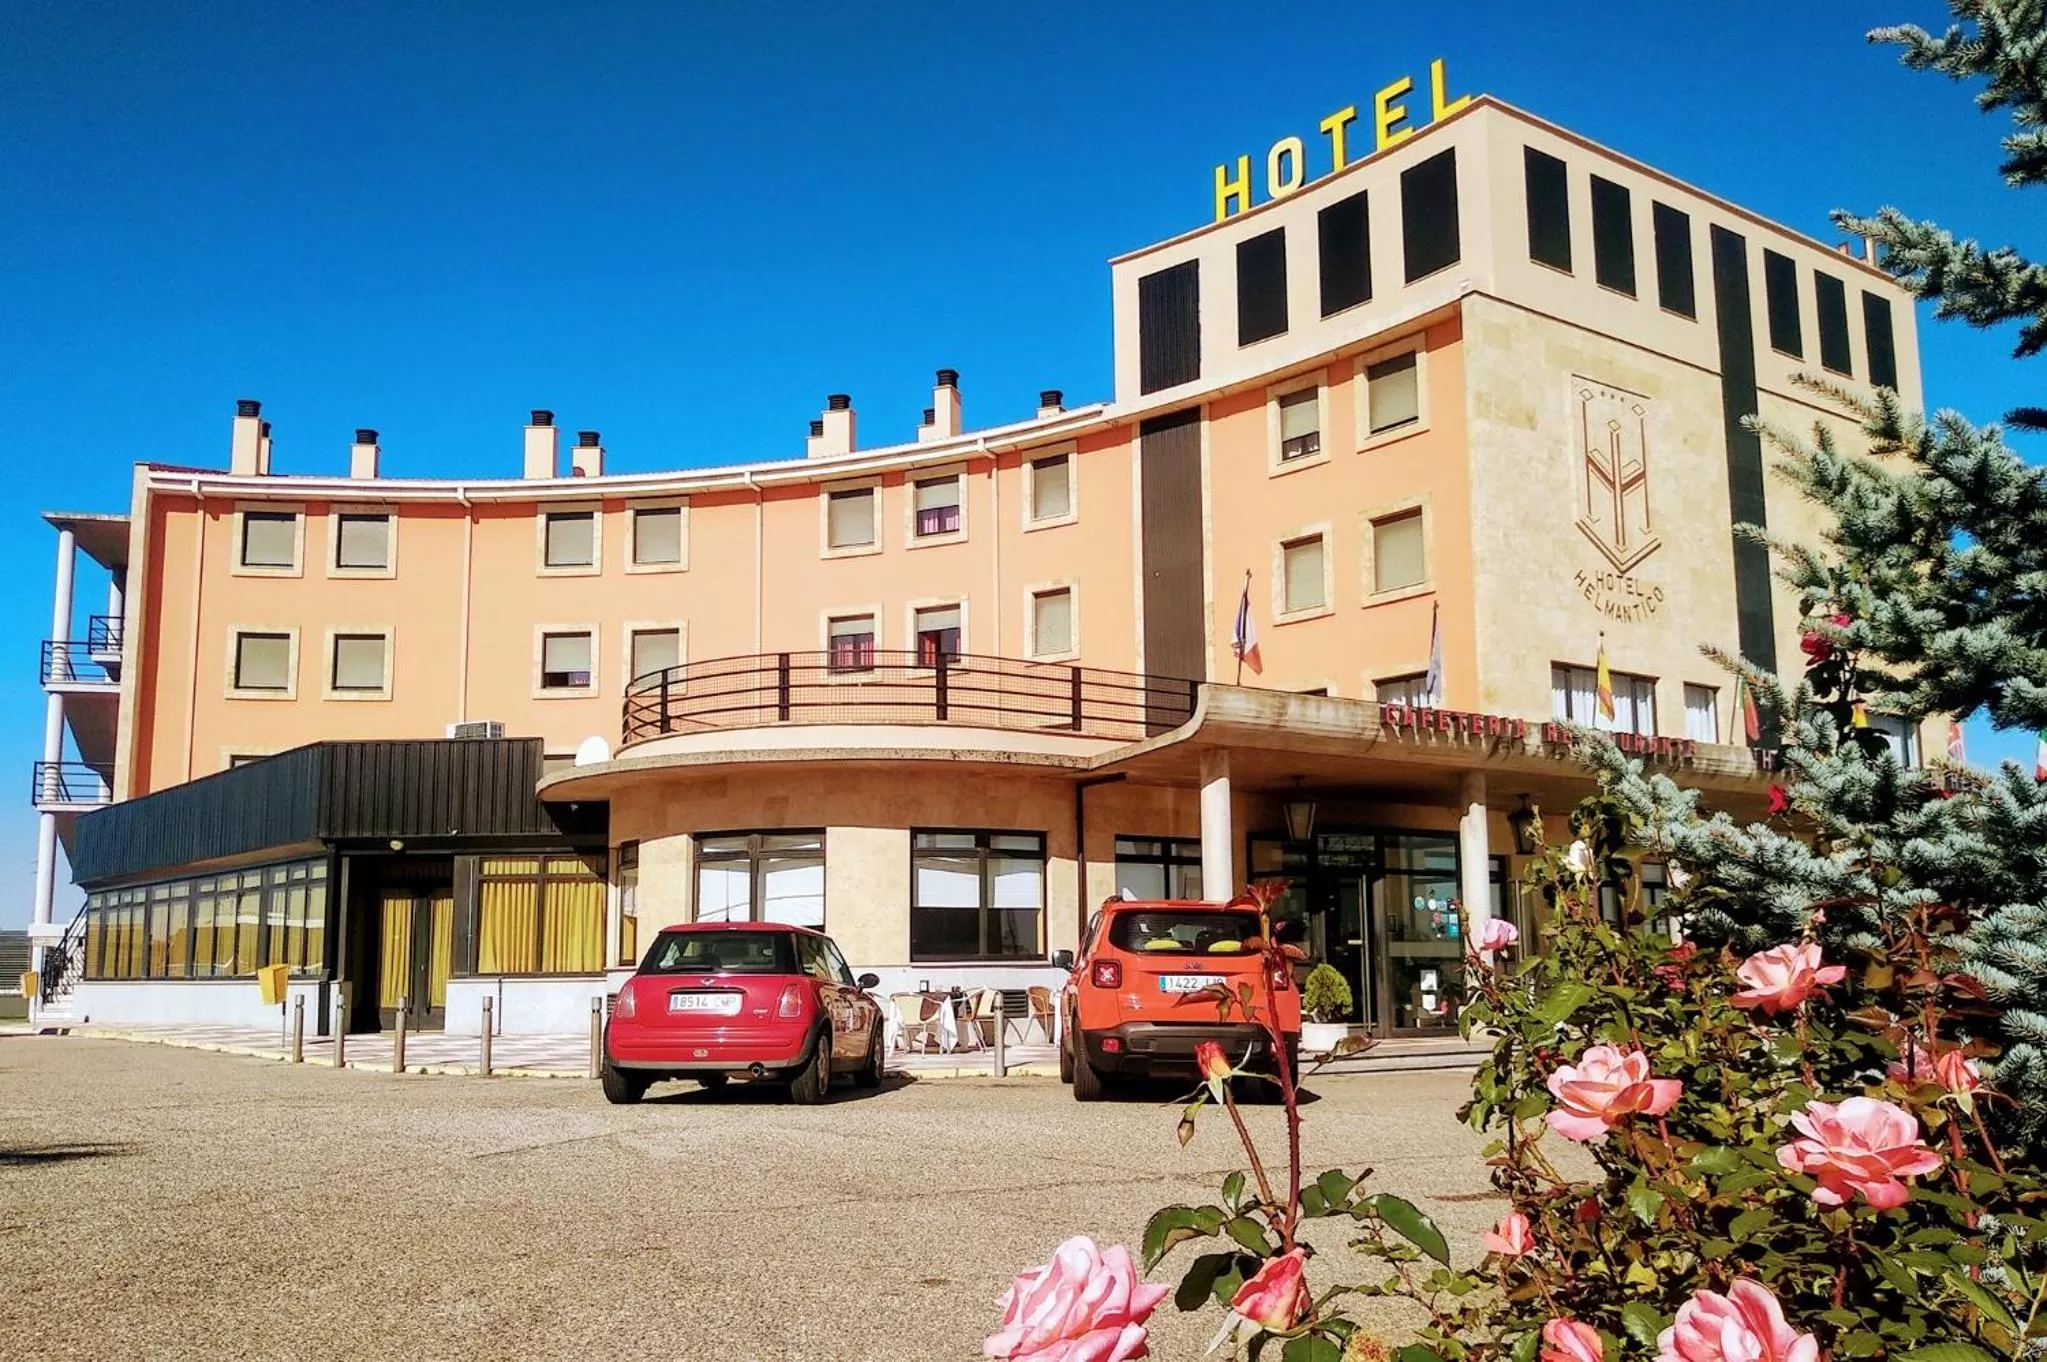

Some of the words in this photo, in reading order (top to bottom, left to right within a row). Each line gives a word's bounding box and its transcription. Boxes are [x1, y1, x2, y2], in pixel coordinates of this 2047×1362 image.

[1214, 57, 1472, 223] HOTEL
[1574, 569, 1664, 623] HELMANTICO
[1595, 570, 1643, 597] HOTEL
[1382, 703, 1527, 740] CAFETERIA
[1168, 978, 1197, 989] 1422
[679, 996, 708, 1008] 8514
